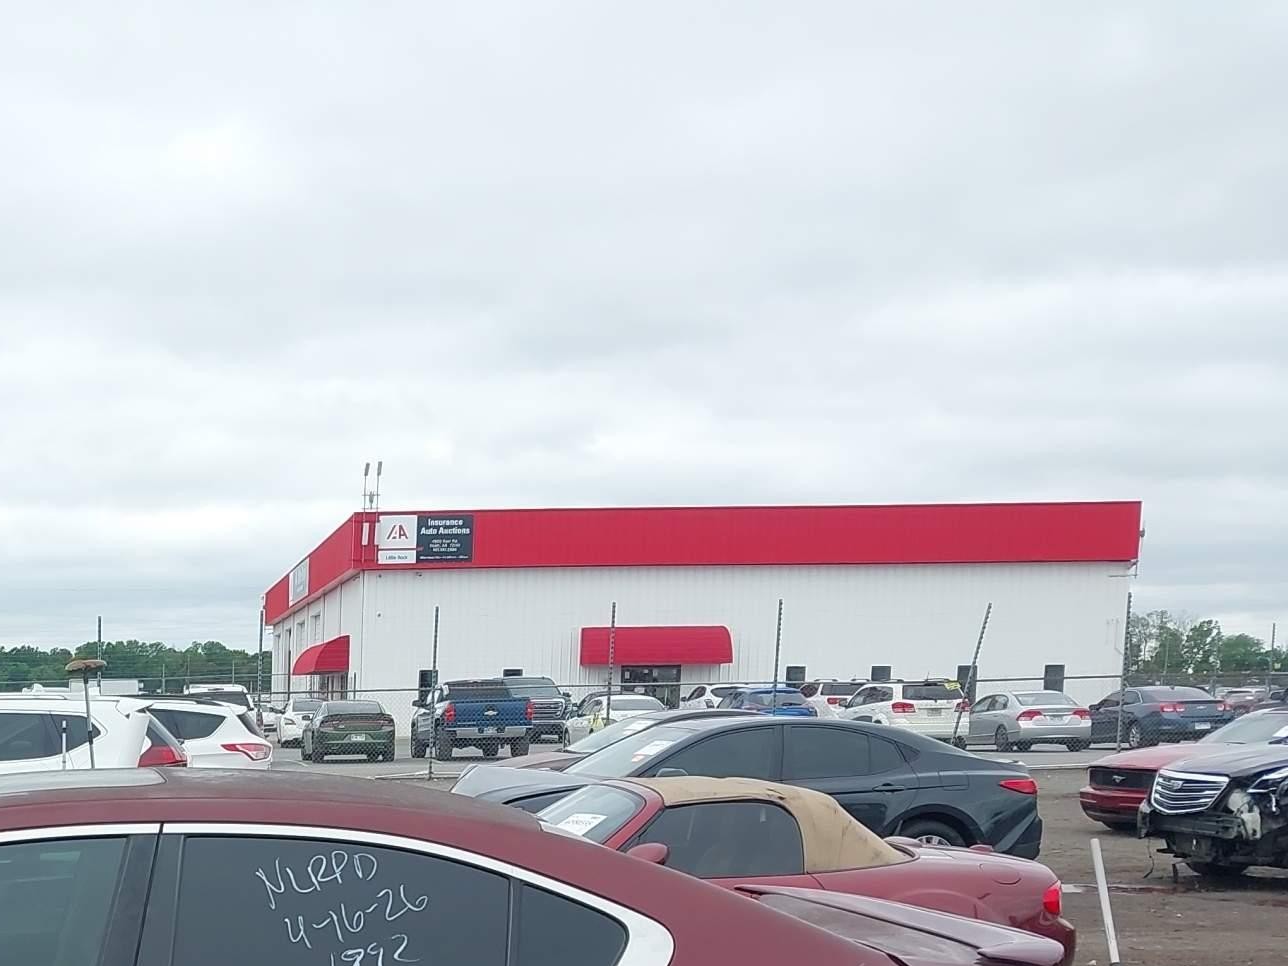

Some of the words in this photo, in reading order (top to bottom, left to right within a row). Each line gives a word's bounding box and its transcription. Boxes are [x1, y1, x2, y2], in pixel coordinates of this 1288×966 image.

[427, 518, 464, 527] Insurance
[420, 527, 438, 535] Auto
[438, 526, 471, 535] Auctions
[255, 850, 378, 910] NLRPD
